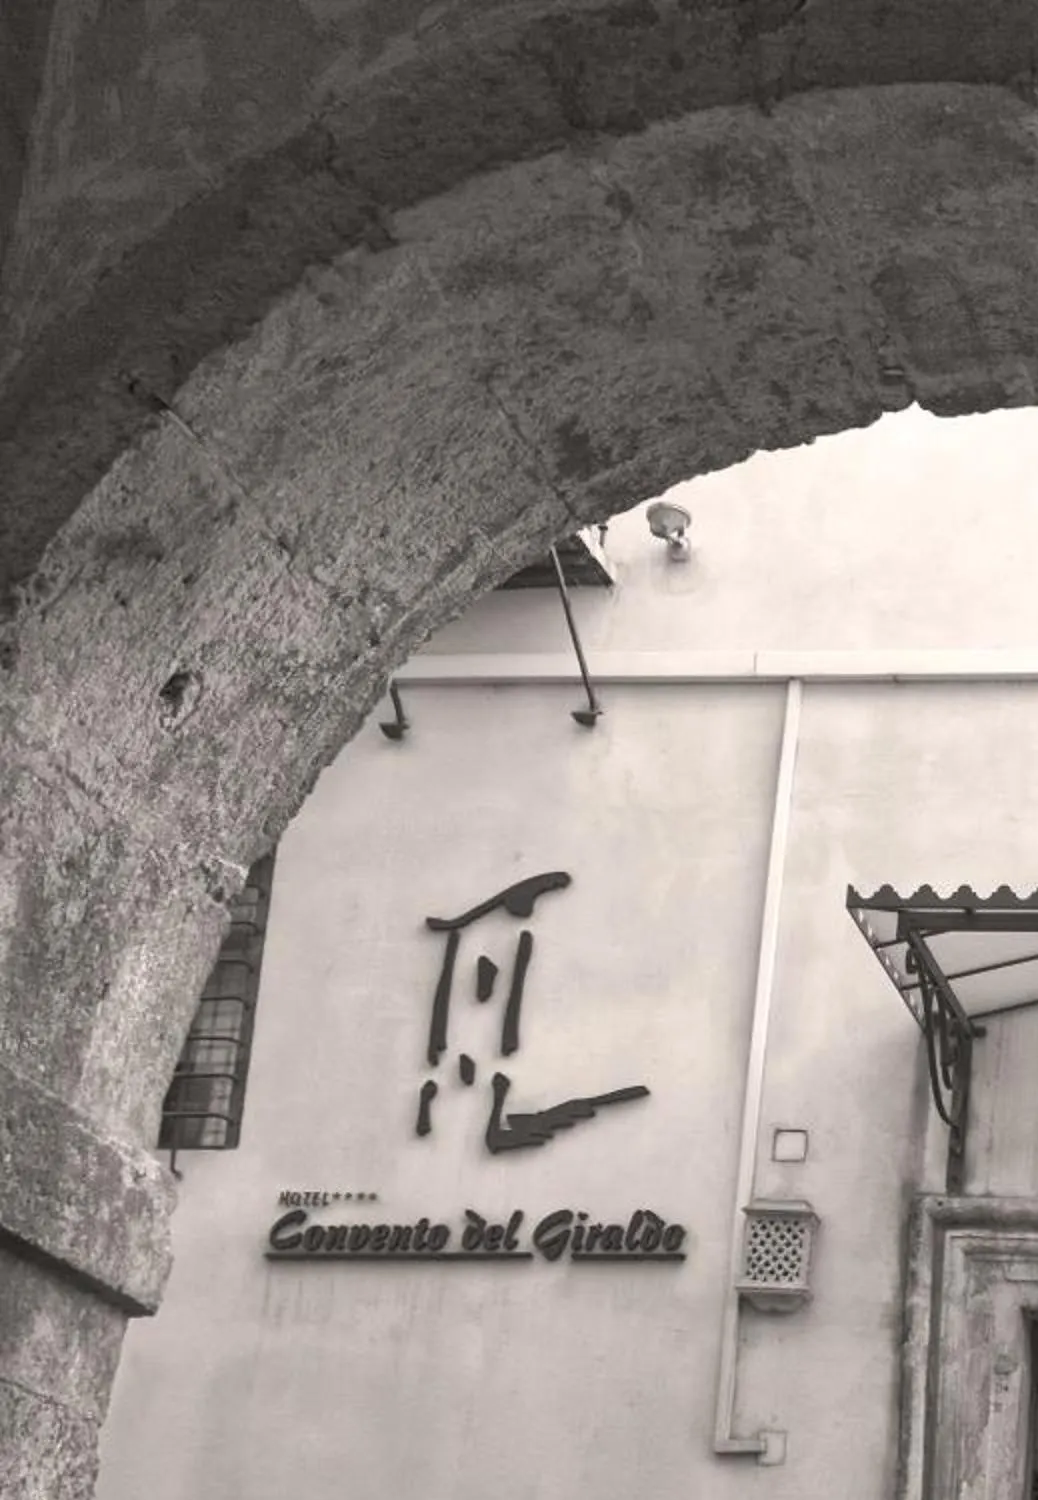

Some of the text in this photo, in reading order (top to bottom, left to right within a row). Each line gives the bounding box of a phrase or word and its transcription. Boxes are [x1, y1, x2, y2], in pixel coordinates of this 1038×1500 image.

[269, 1208, 687, 1261] Convento del Giraldo
